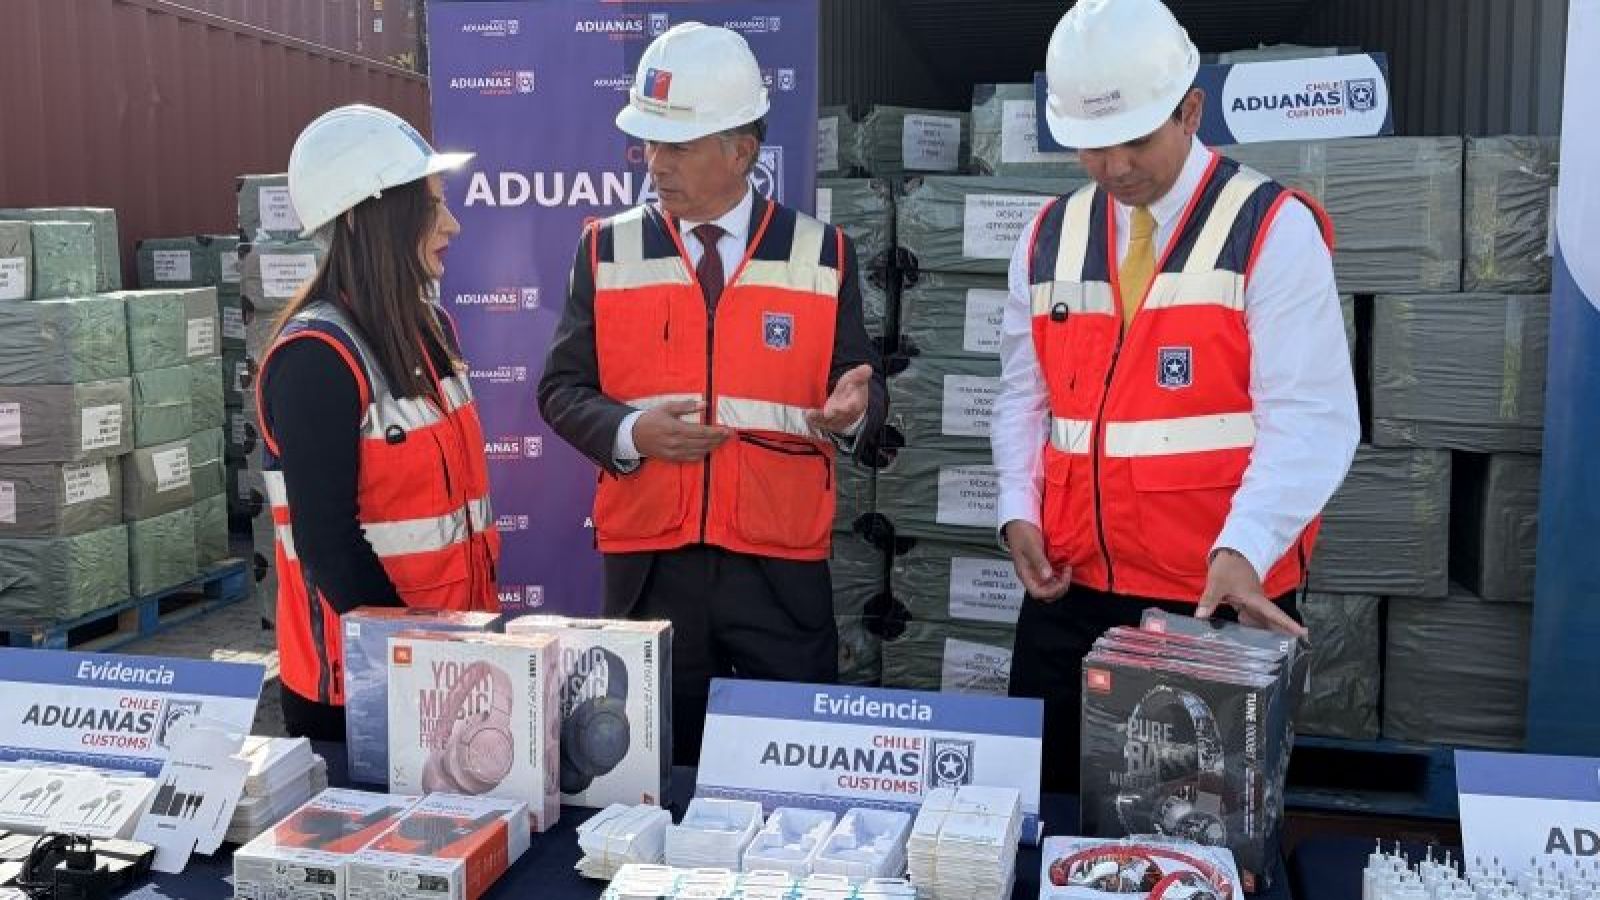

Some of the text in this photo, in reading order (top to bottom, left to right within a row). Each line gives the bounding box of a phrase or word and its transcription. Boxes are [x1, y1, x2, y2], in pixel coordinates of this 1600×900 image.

[575, 20, 643, 33] ADUANAS
[450, 77, 511, 89] ADUANAS
[1231, 91, 1341, 113] ADUANAS
[464, 172, 660, 206] ADUANA
[455, 293, 517, 304] ADUANAS
[484, 442, 519, 454] ANAS
[77, 660, 175, 685] Evidencia
[119, 697, 160, 711] CHILE
[813, 693, 933, 721] Evidencia
[21, 704, 154, 734] ADUANAS
[81, 733, 149, 750] CUSTOMS
[873, 735, 921, 751] CHILE
[759, 741, 920, 777] ADUANAS
[837, 775, 919, 795] CUSTOMS
